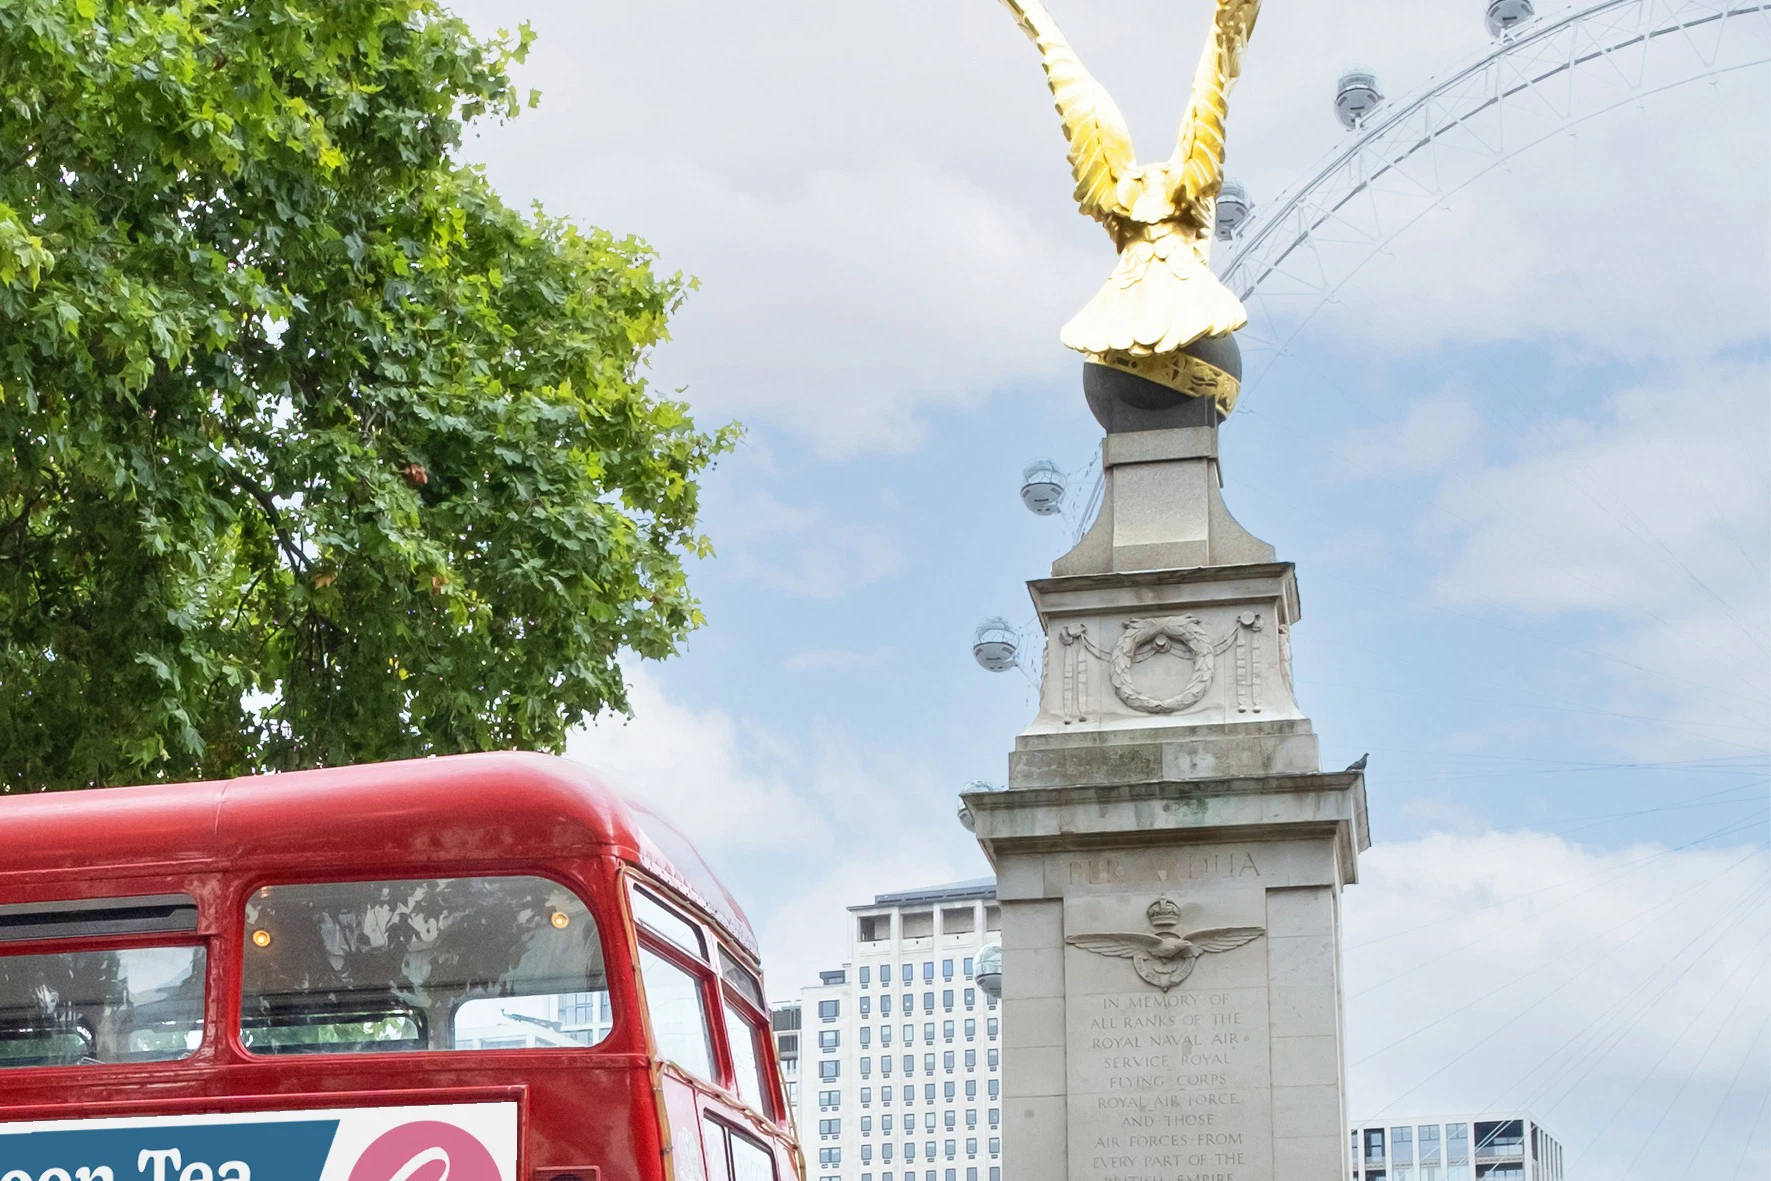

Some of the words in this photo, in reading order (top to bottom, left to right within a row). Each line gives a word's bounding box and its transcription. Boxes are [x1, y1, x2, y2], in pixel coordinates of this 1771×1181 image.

[1103, 998, 1119, 1009] IN
[1129, 993, 1199, 1008] MEMORY
[1209, 994, 1230, 1005] OF
[1091, 1018, 1116, 1029] ALL
[1124, 1016, 1175, 1029] RANKS
[1183, 1015, 1201, 1026] OF
[1213, 1013, 1241, 1025] THE
[1092, 1037, 1141, 1048] ROYAL
[1150, 1035, 1201, 1047] NAVAL
[1212, 1033, 1239, 1045] AIR
[1105, 1056, 1169, 1069] SERVICE
[1182, 1053, 1232, 1065] ROYAL
[1110, 1076, 1164, 1088] FLYING
[1177, 1074, 1226, 1087] CORPS
[1099, 1096, 1146, 1109] ROYAL
[1155, 1096, 1180, 1107] AIR
[1122, 1116, 1154, 1127] AND
[1164, 1114, 1214, 1126] THOSE
[1095, 1137, 1120, 1148] AIR
[1130, 1135, 1187, 1147] FORCES
[1198, 1133, 1242, 1145] FROM
[1094, 1156, 1137, 1168] EVERY
[1145, 1155, 1181, 1167] PART
[1189, 1155, 1206, 1166] OF
[1215, 1153, 1245, 1165] THE
